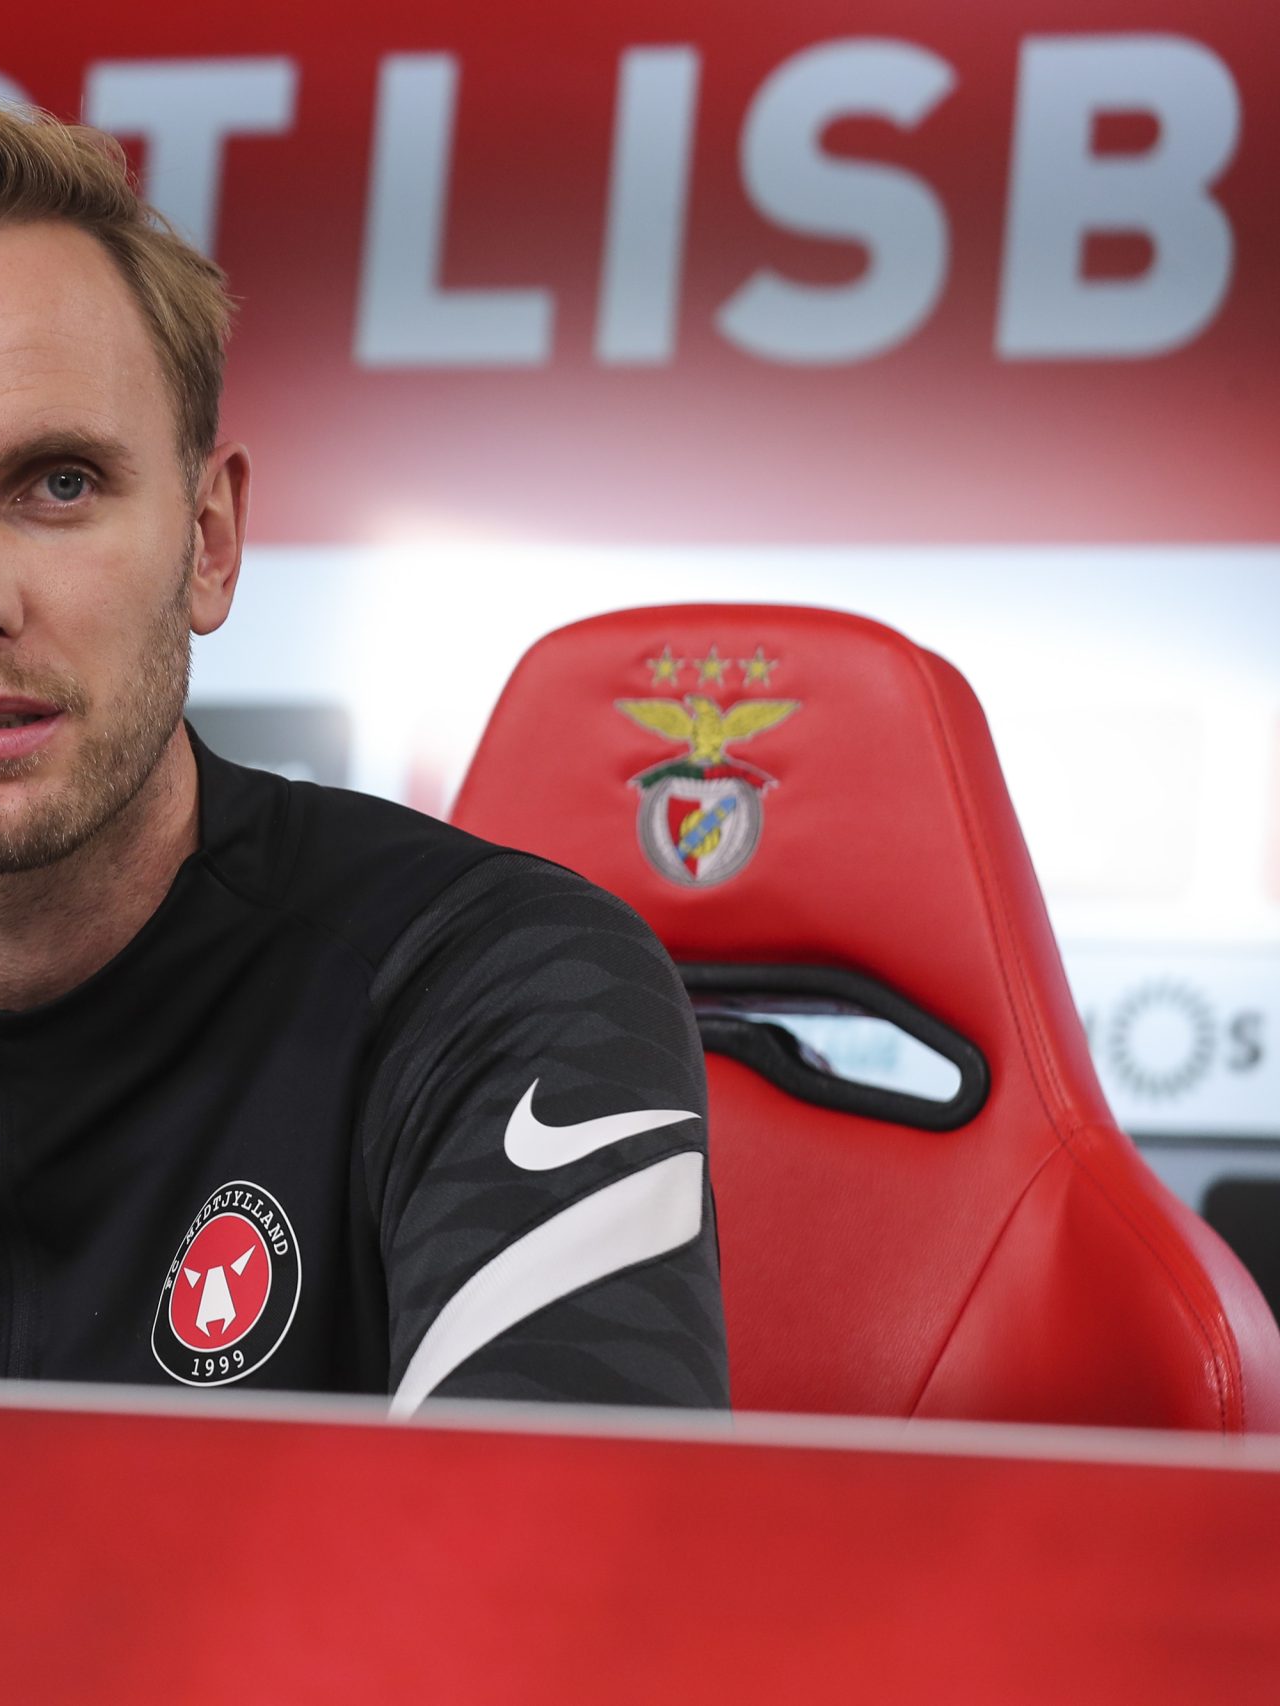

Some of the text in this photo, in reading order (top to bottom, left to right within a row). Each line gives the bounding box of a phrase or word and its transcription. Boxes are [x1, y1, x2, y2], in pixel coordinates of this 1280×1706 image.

[352, 34, 1242, 368] LISB
[185, 1189, 289, 1256] MIDTJYLLAND
[191, 1349, 245, 1377] 1999
